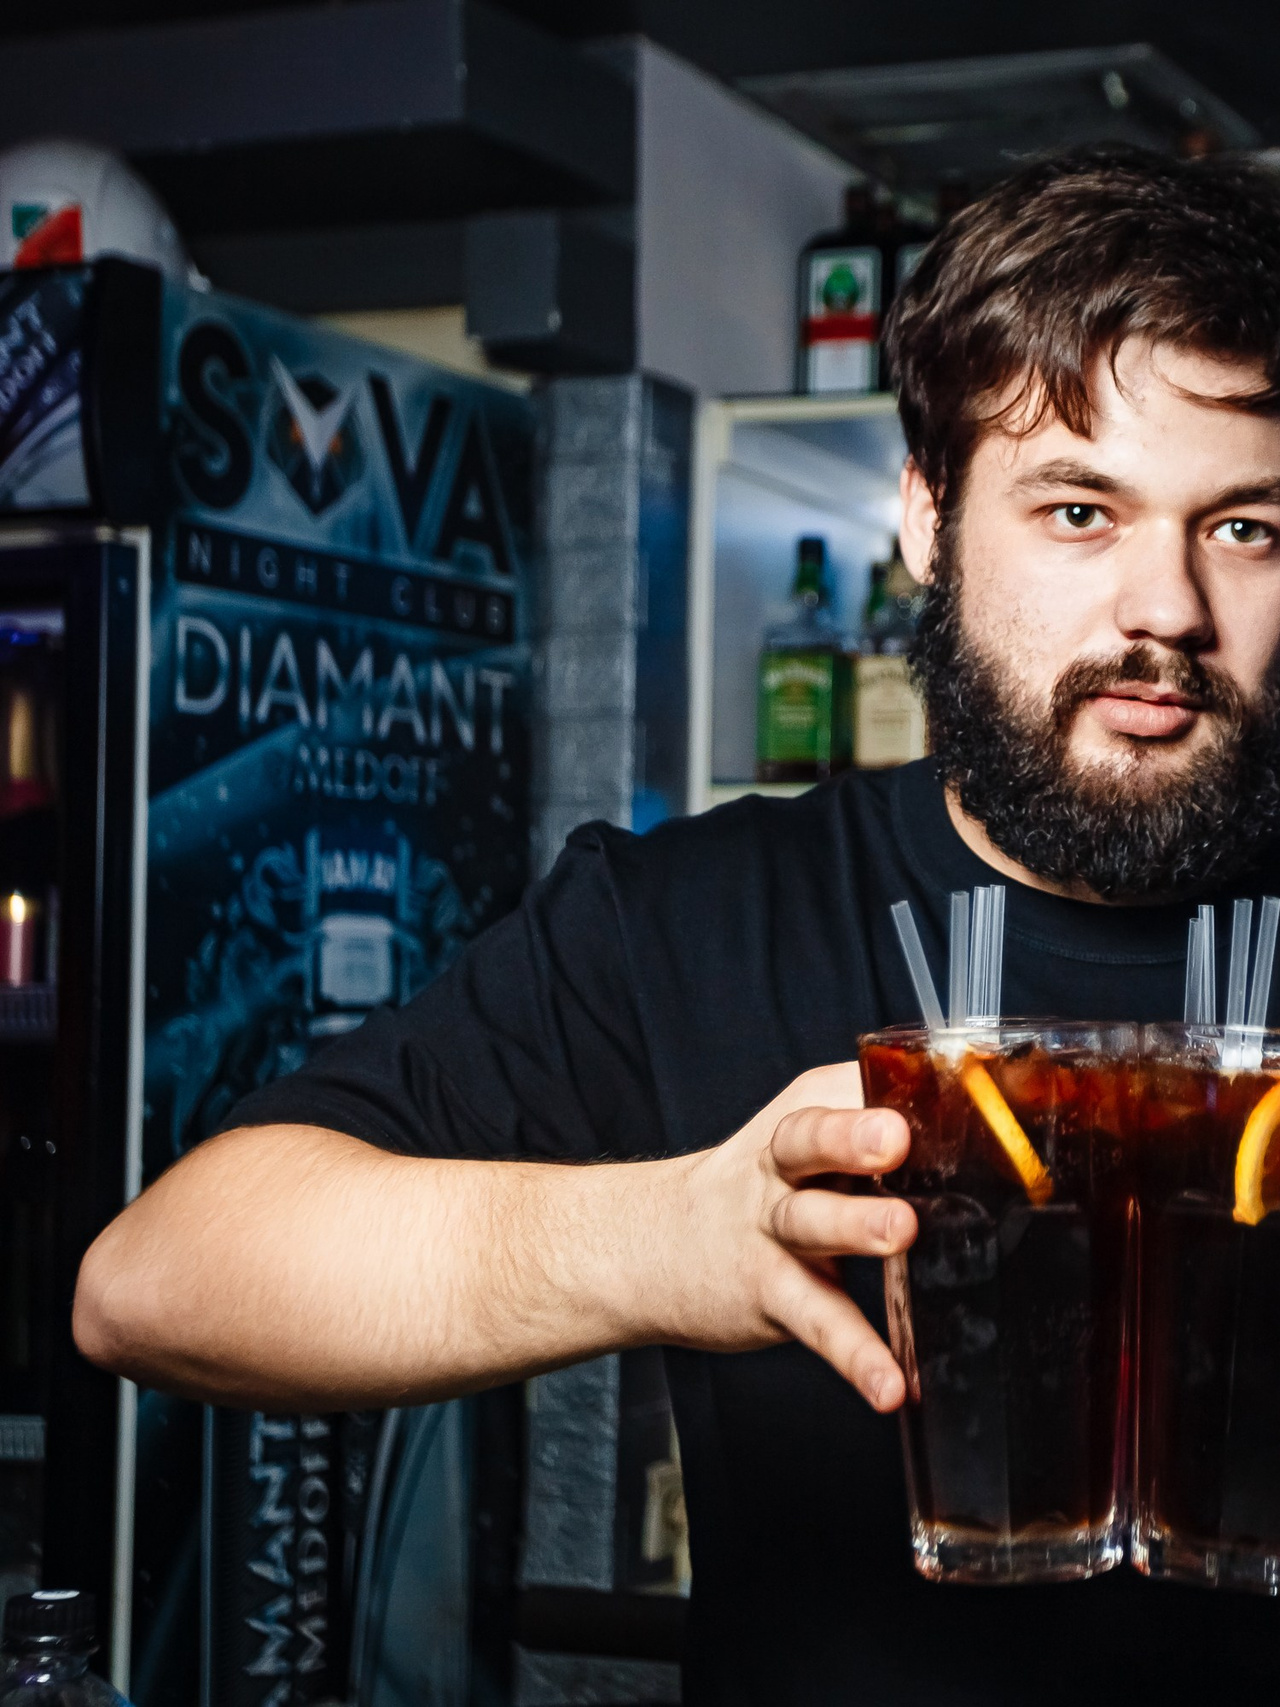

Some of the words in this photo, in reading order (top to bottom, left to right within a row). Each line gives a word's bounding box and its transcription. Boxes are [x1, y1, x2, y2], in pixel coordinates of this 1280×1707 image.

[187, 532, 354, 600] NIGHT
[389, 575, 508, 635] CLUB
[174, 613, 516, 757] DIAMANT
